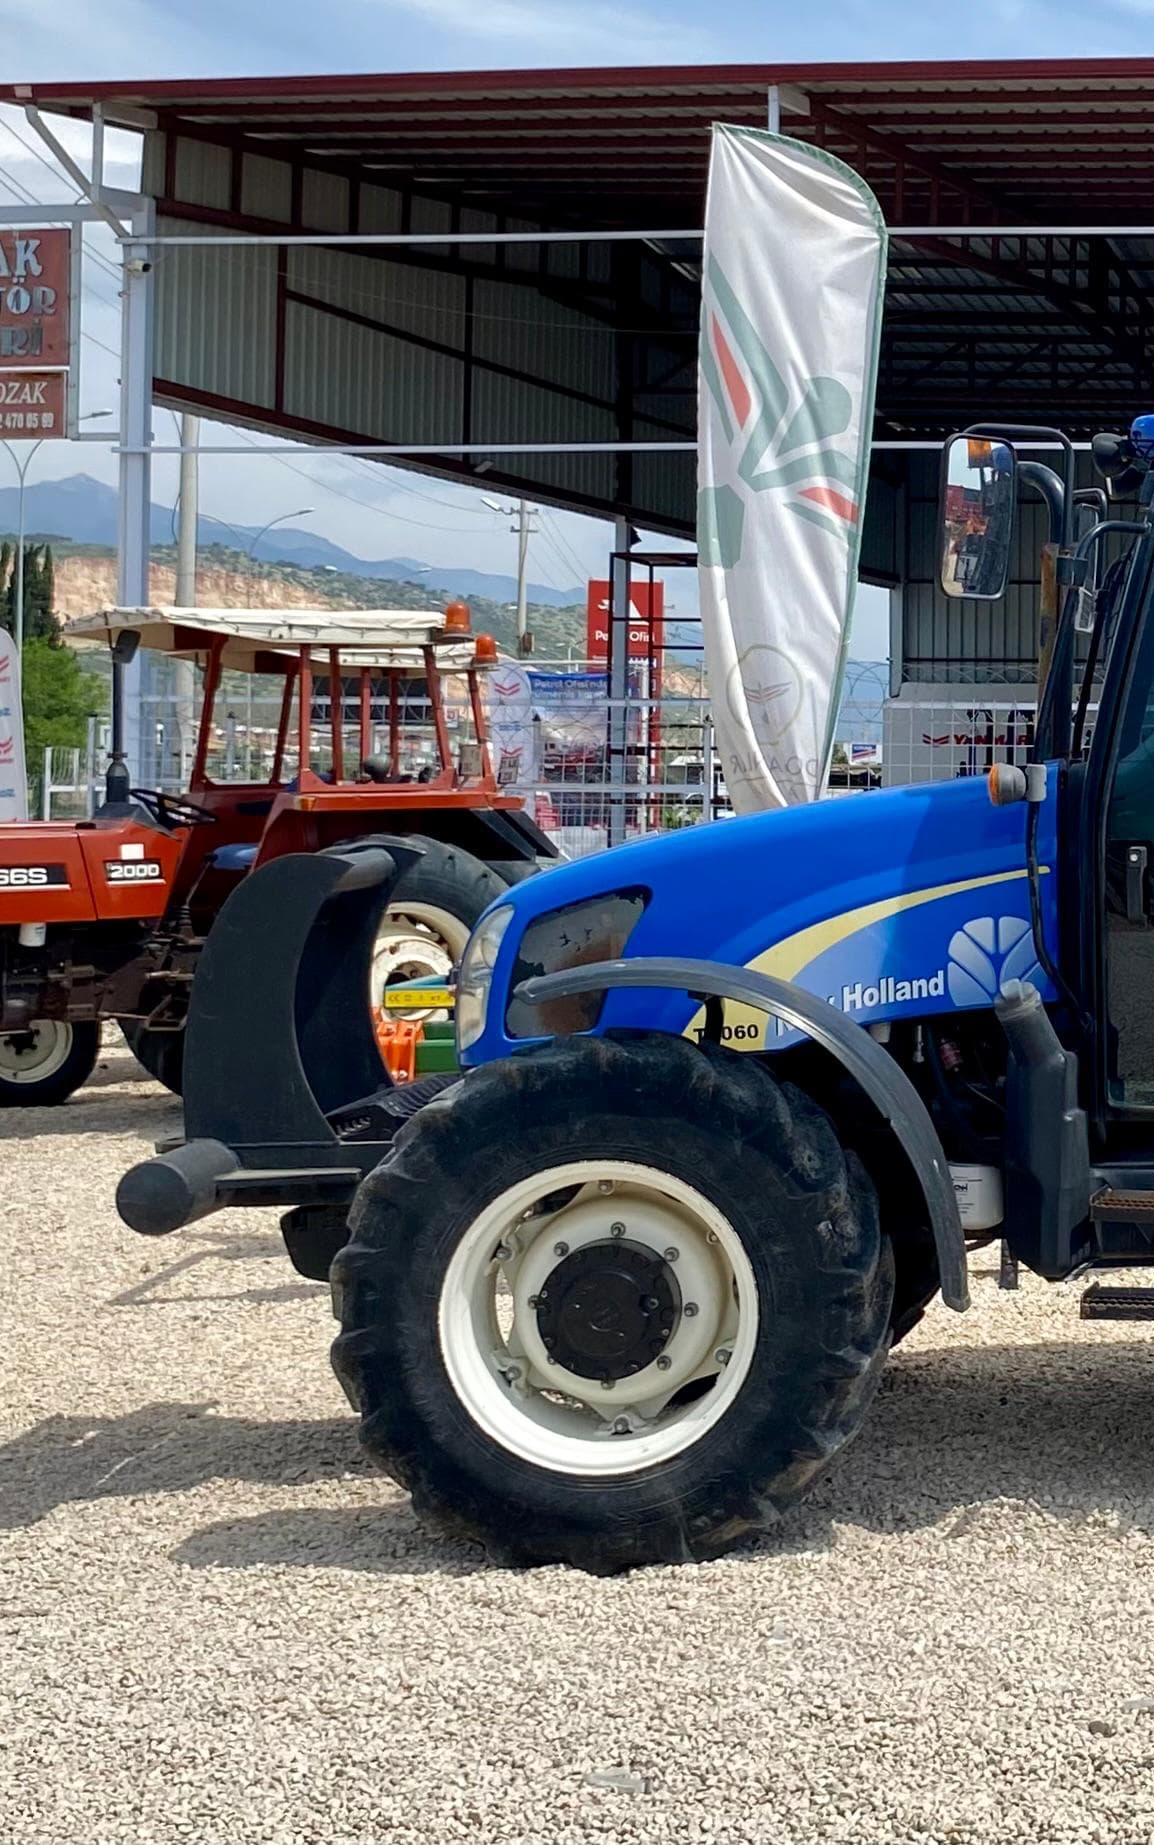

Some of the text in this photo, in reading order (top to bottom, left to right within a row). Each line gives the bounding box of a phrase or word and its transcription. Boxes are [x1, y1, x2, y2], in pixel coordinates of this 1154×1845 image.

[0, 276, 56, 316] ÖR
[953, 734, 1030, 745] YANMR
[110, 863, 160, 879] 2000
[841, 970, 945, 1012] Holland
[693, 1025, 759, 1042] T060
